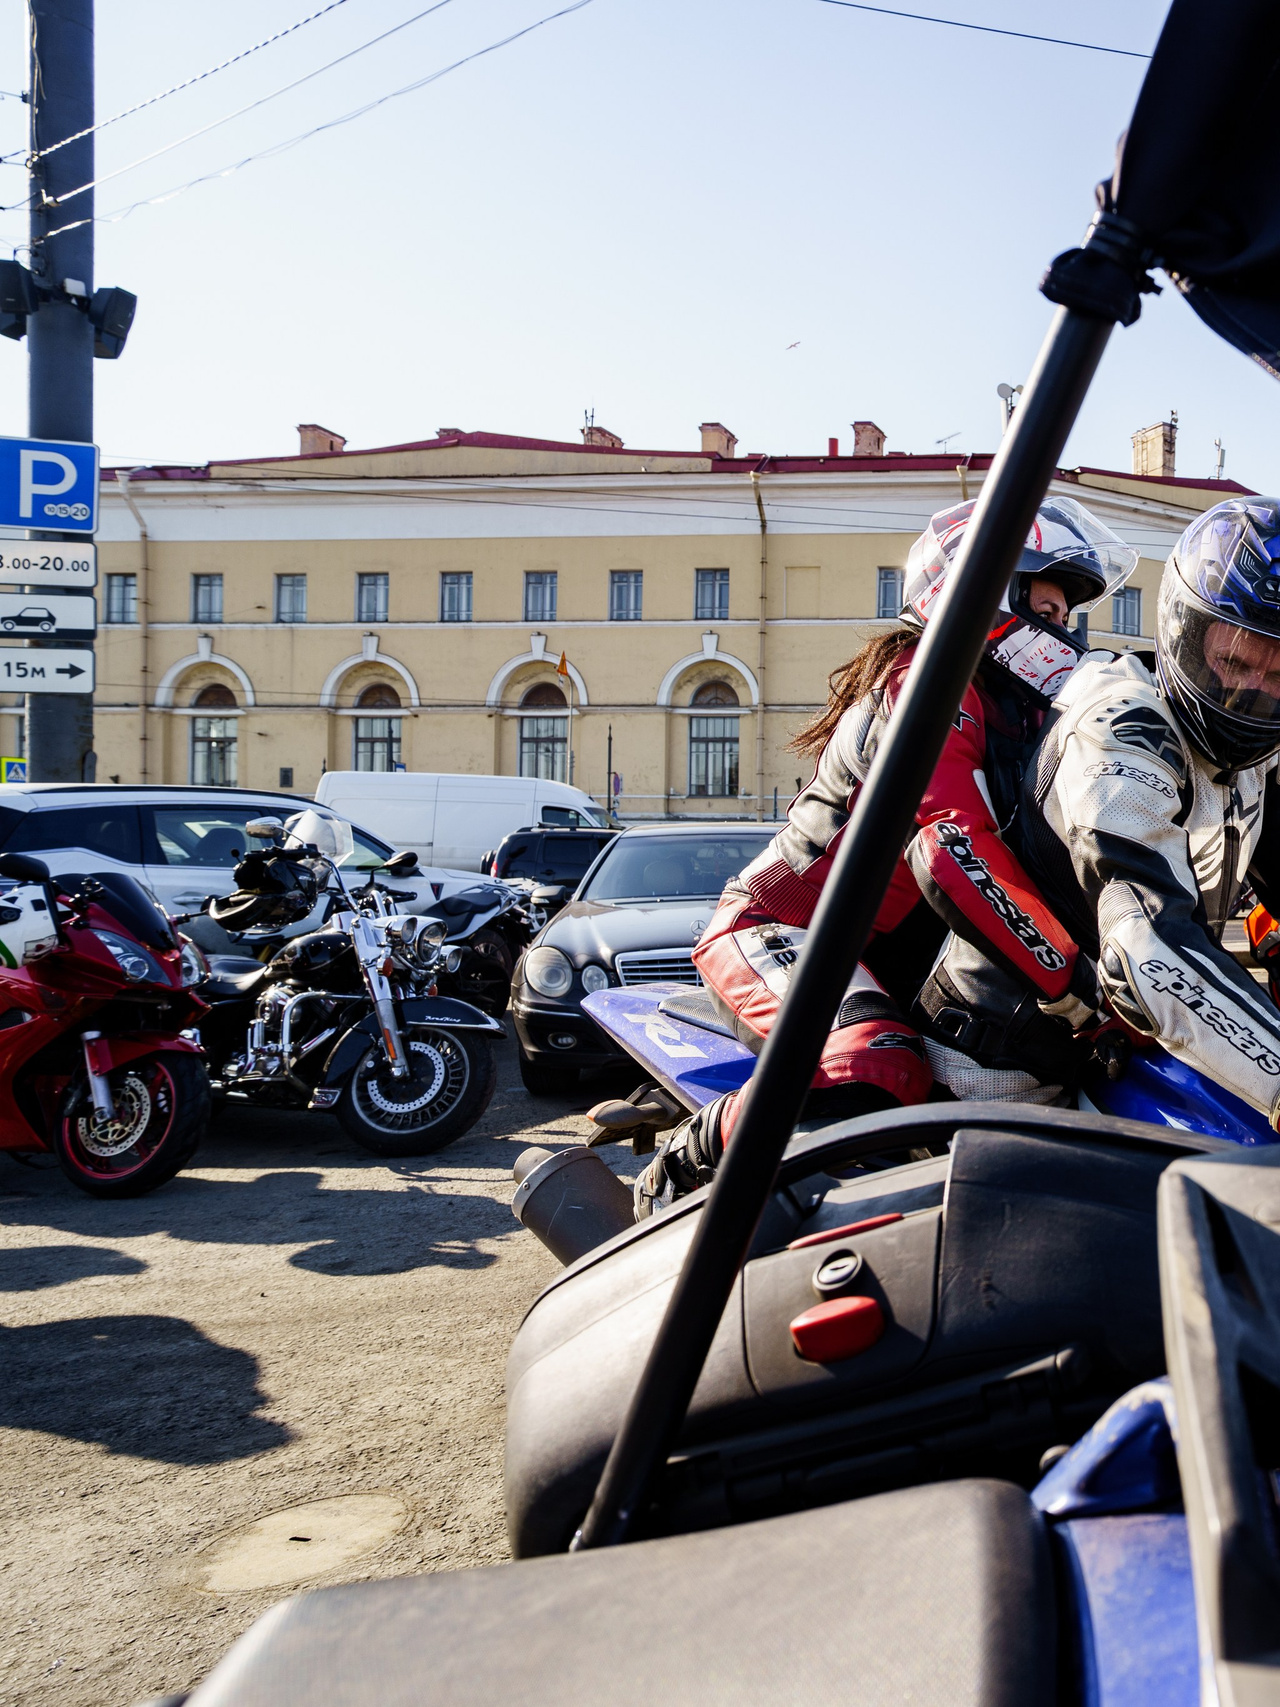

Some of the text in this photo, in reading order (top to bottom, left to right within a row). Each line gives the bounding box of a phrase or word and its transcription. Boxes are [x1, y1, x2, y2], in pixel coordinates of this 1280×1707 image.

[19, 449, 78, 518] P
[58, 506, 68, 515] 15
[72, 507, 88, 517] 20
[1083, 761, 1176, 798] alpinestars
[934, 822, 1067, 971] alpinestars
